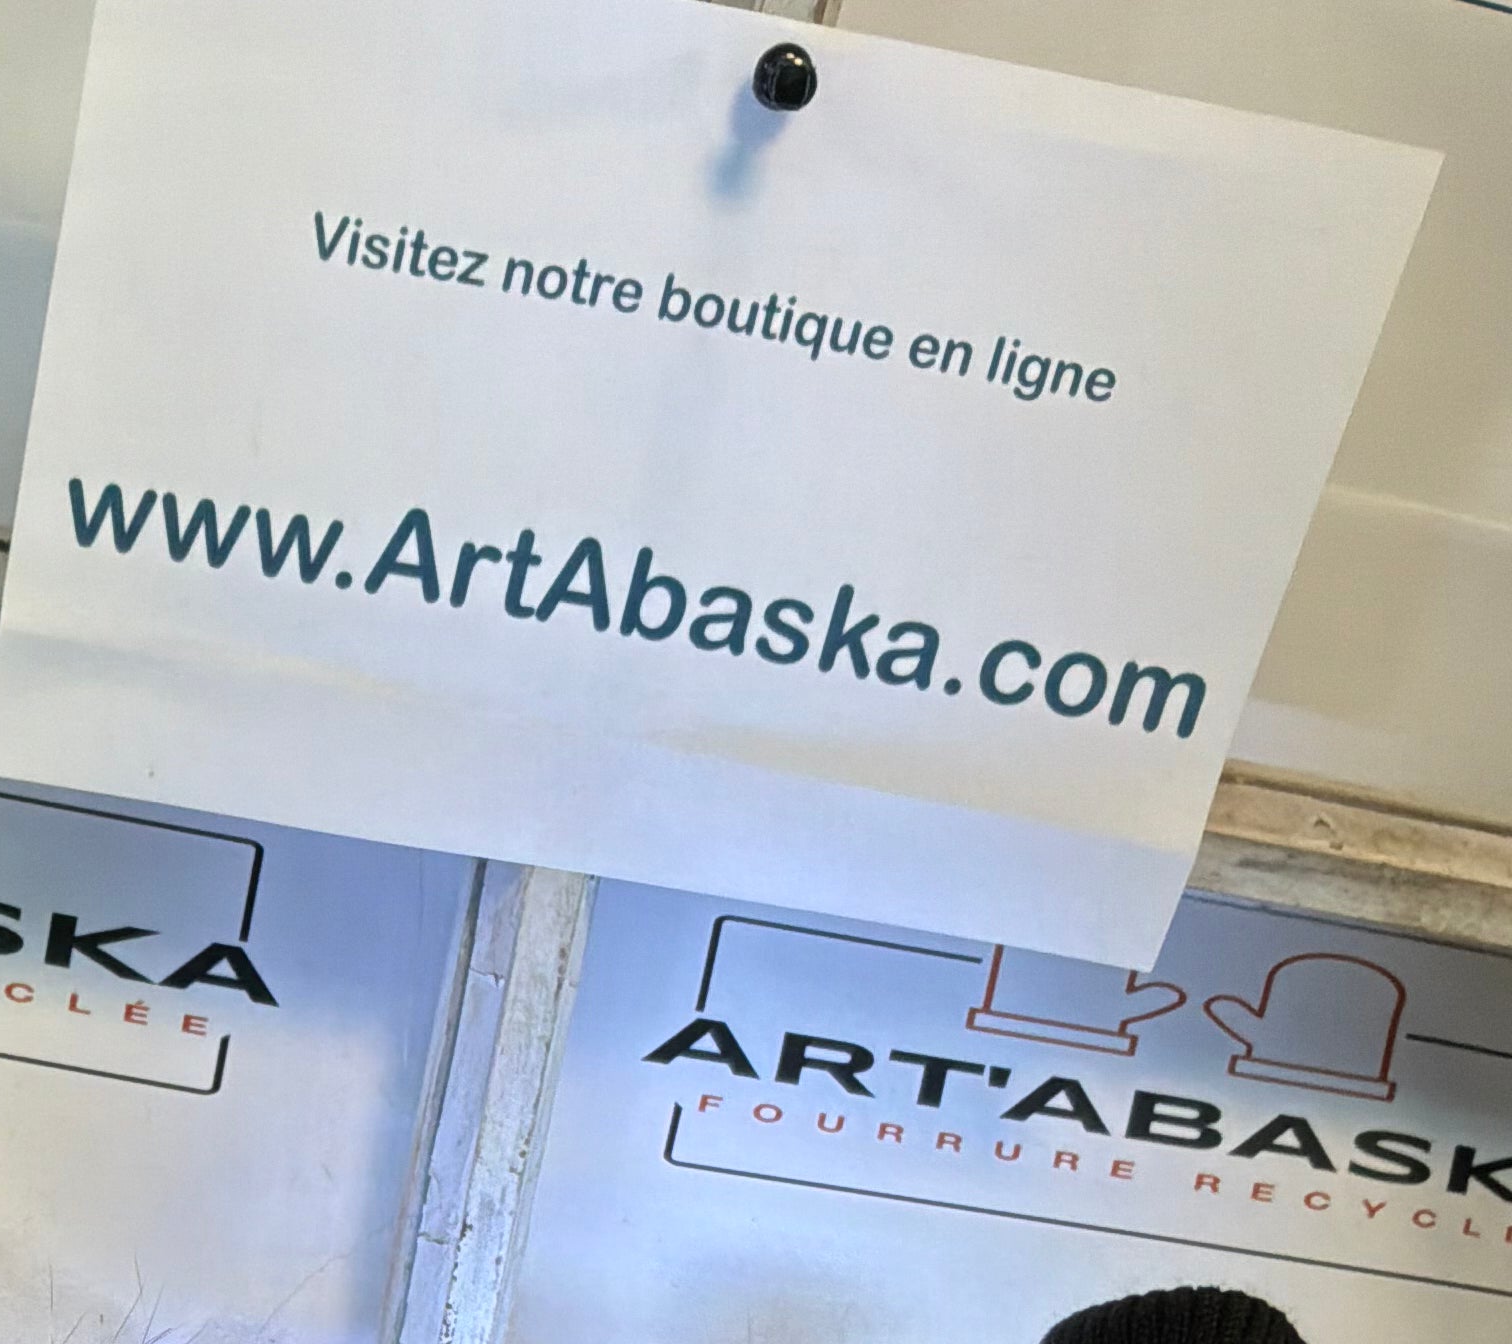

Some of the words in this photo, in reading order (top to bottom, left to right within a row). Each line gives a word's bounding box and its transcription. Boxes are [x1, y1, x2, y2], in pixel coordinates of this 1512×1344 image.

[313, 212, 489, 286] Visitez
[502, 258, 643, 313] notre
[658, 273, 894, 361] boutique
[909, 334, 973, 376] en
[987, 336, 1117, 403] ligne
[67, 477, 1207, 739] www.ArtAbaska.com
[697, 1096, 1135, 1181] FOURRURE
